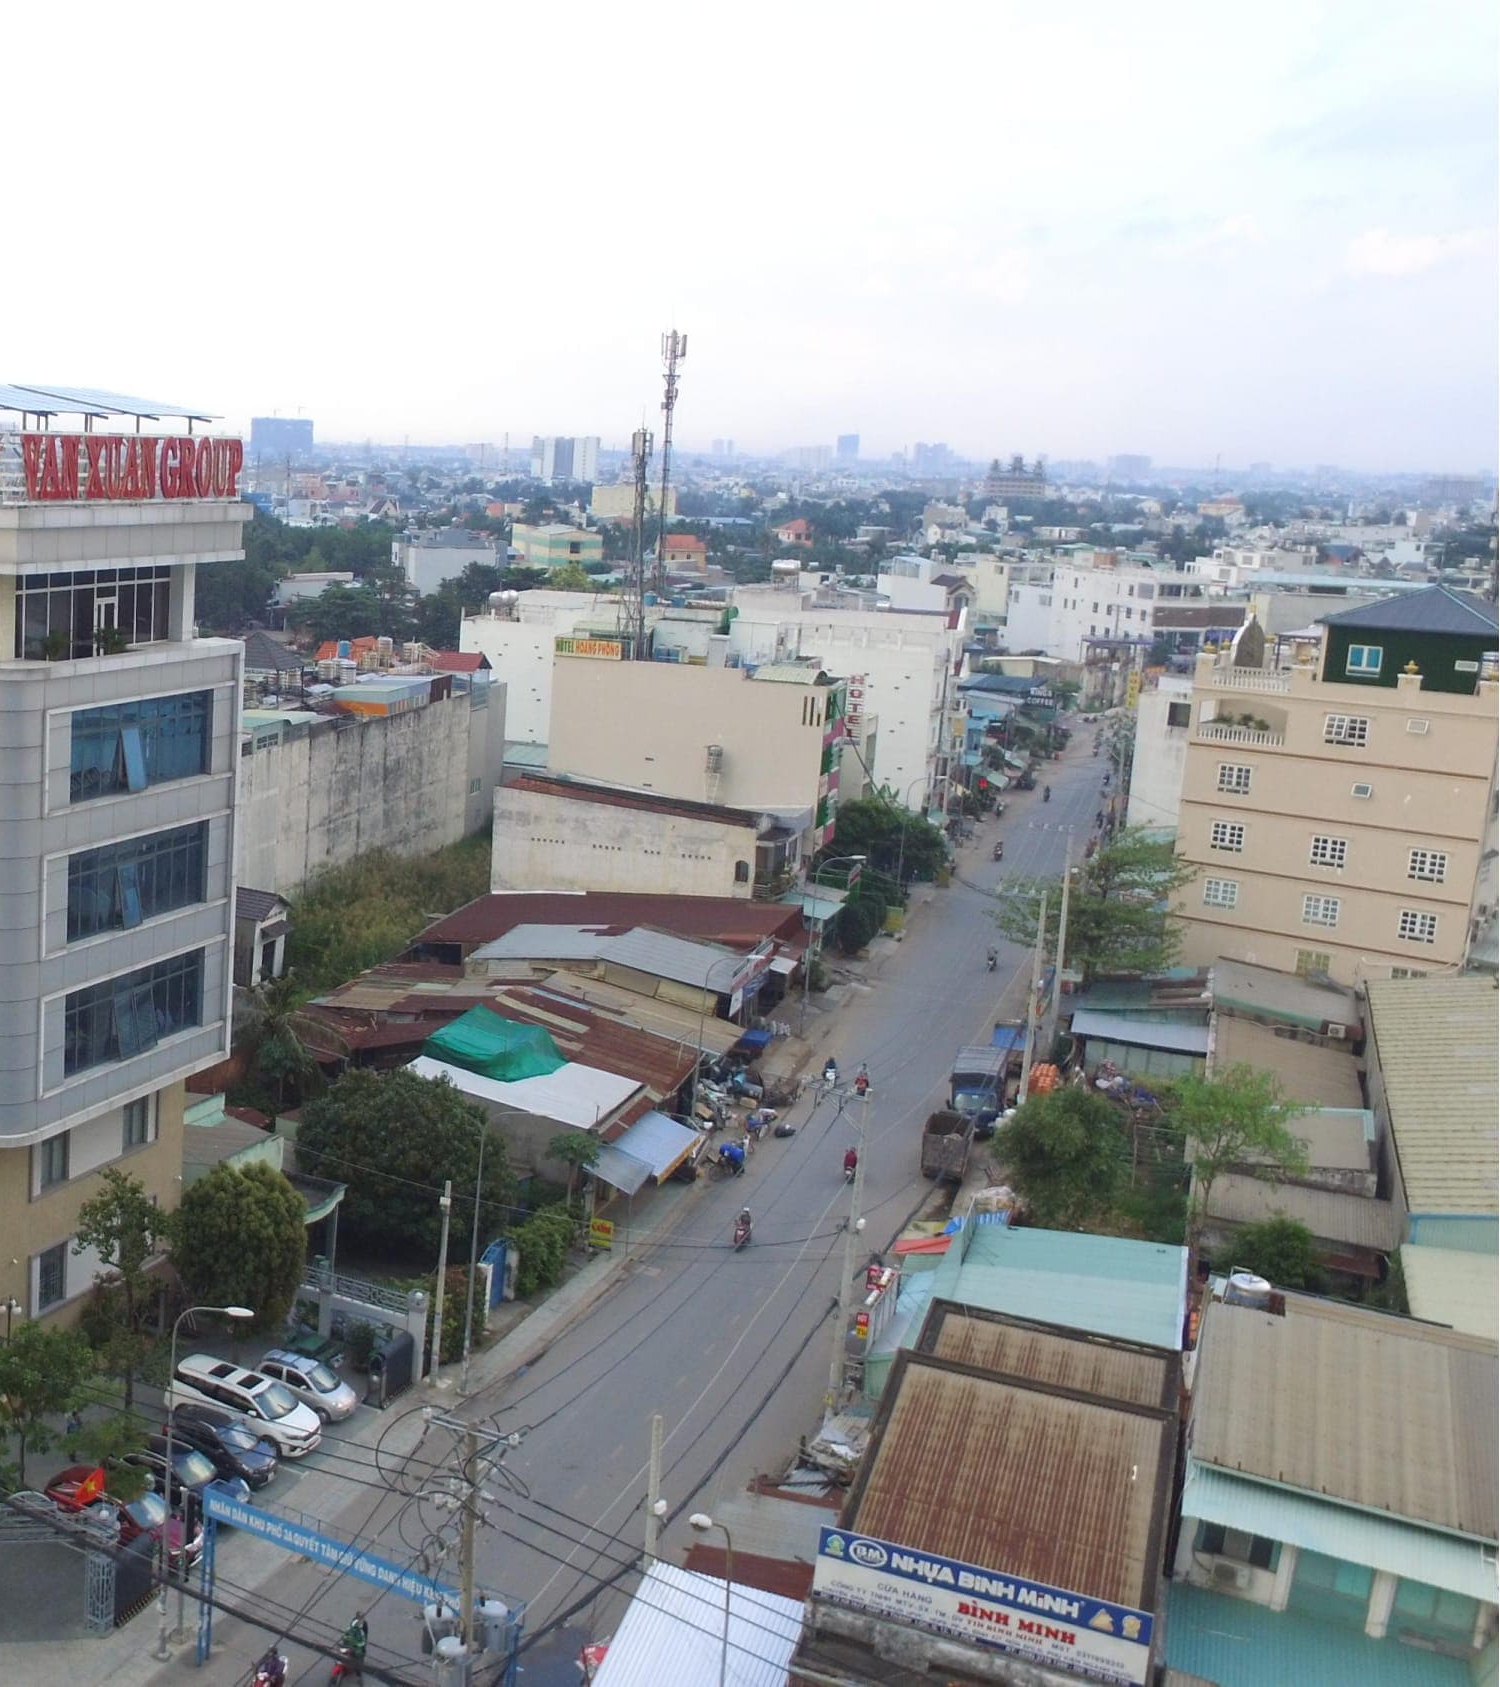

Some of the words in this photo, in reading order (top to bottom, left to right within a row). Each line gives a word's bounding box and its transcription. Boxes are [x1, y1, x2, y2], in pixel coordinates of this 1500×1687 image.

[159, 436, 244, 499] GROUP
[847, 675, 865, 738] HOTEL
[265, 1523, 283, 1538] PHỐ
[891, 1552, 955, 1584] NHỰA
[957, 1599, 1011, 1627] BÌNH
[1018, 1617, 1078, 1645] MINH
